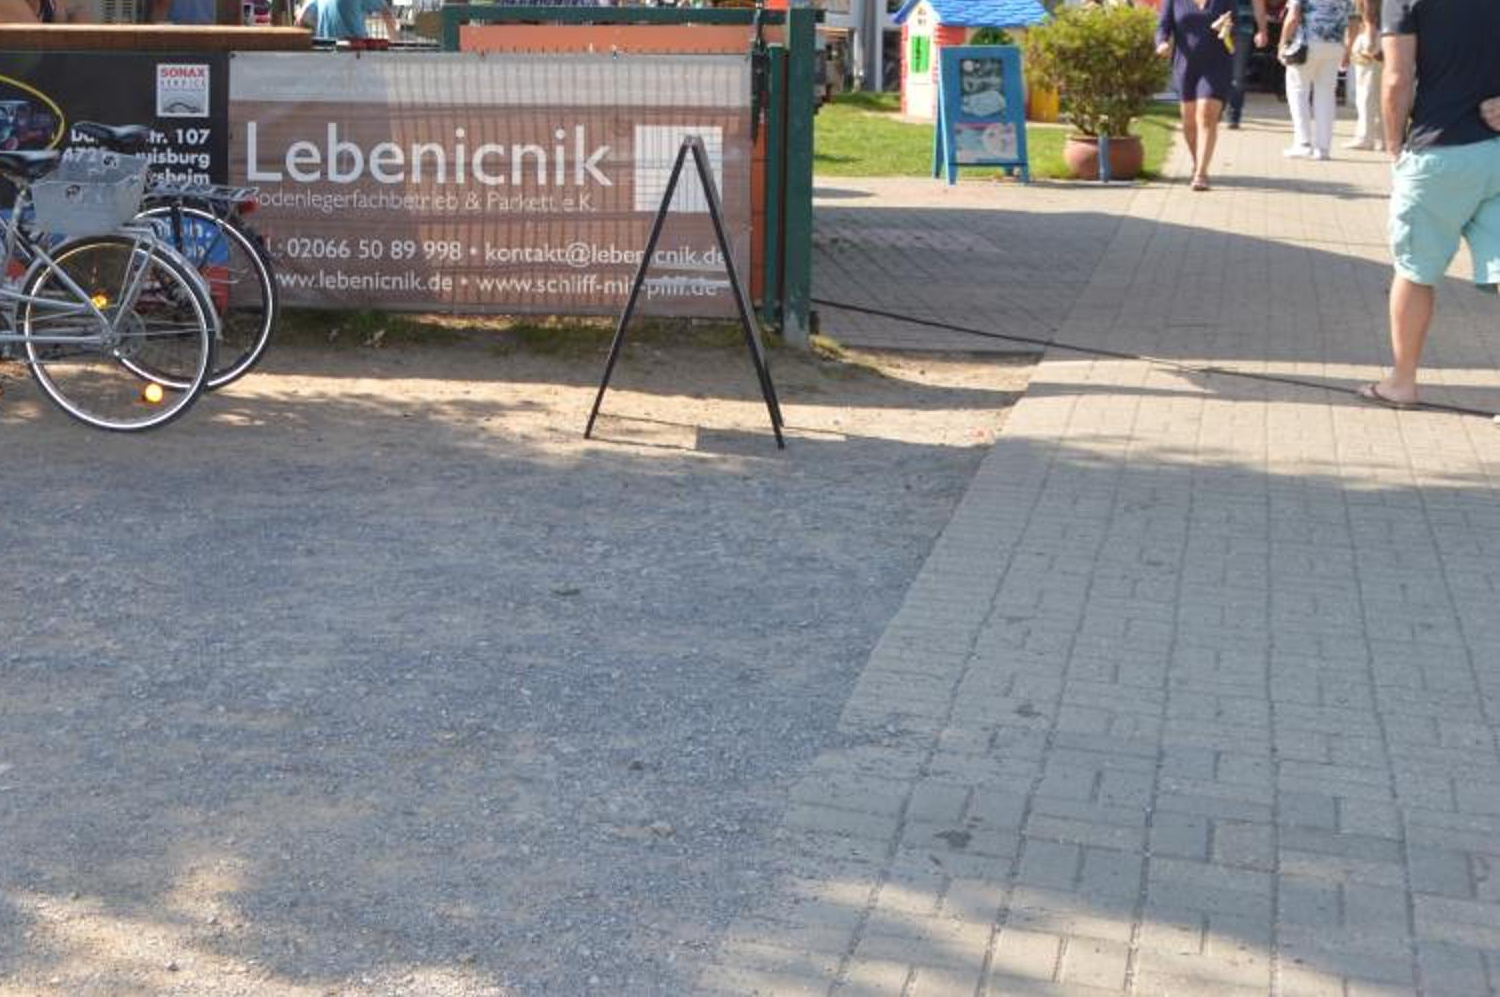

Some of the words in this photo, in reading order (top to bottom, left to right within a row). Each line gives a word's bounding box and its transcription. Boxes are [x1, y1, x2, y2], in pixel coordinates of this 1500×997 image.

[161, 67, 205, 78] SONAX
[176, 129, 211, 145] 107
[247, 122, 613, 187] Lebenicnik
[465, 193, 481, 209] &
[287, 238, 350, 258] 02066
[358, 239, 383, 258] 50
[390, 240, 416, 259] 89
[423, 241, 461, 261] 998
[275, 270, 452, 291] ww.lebenicnik.de
